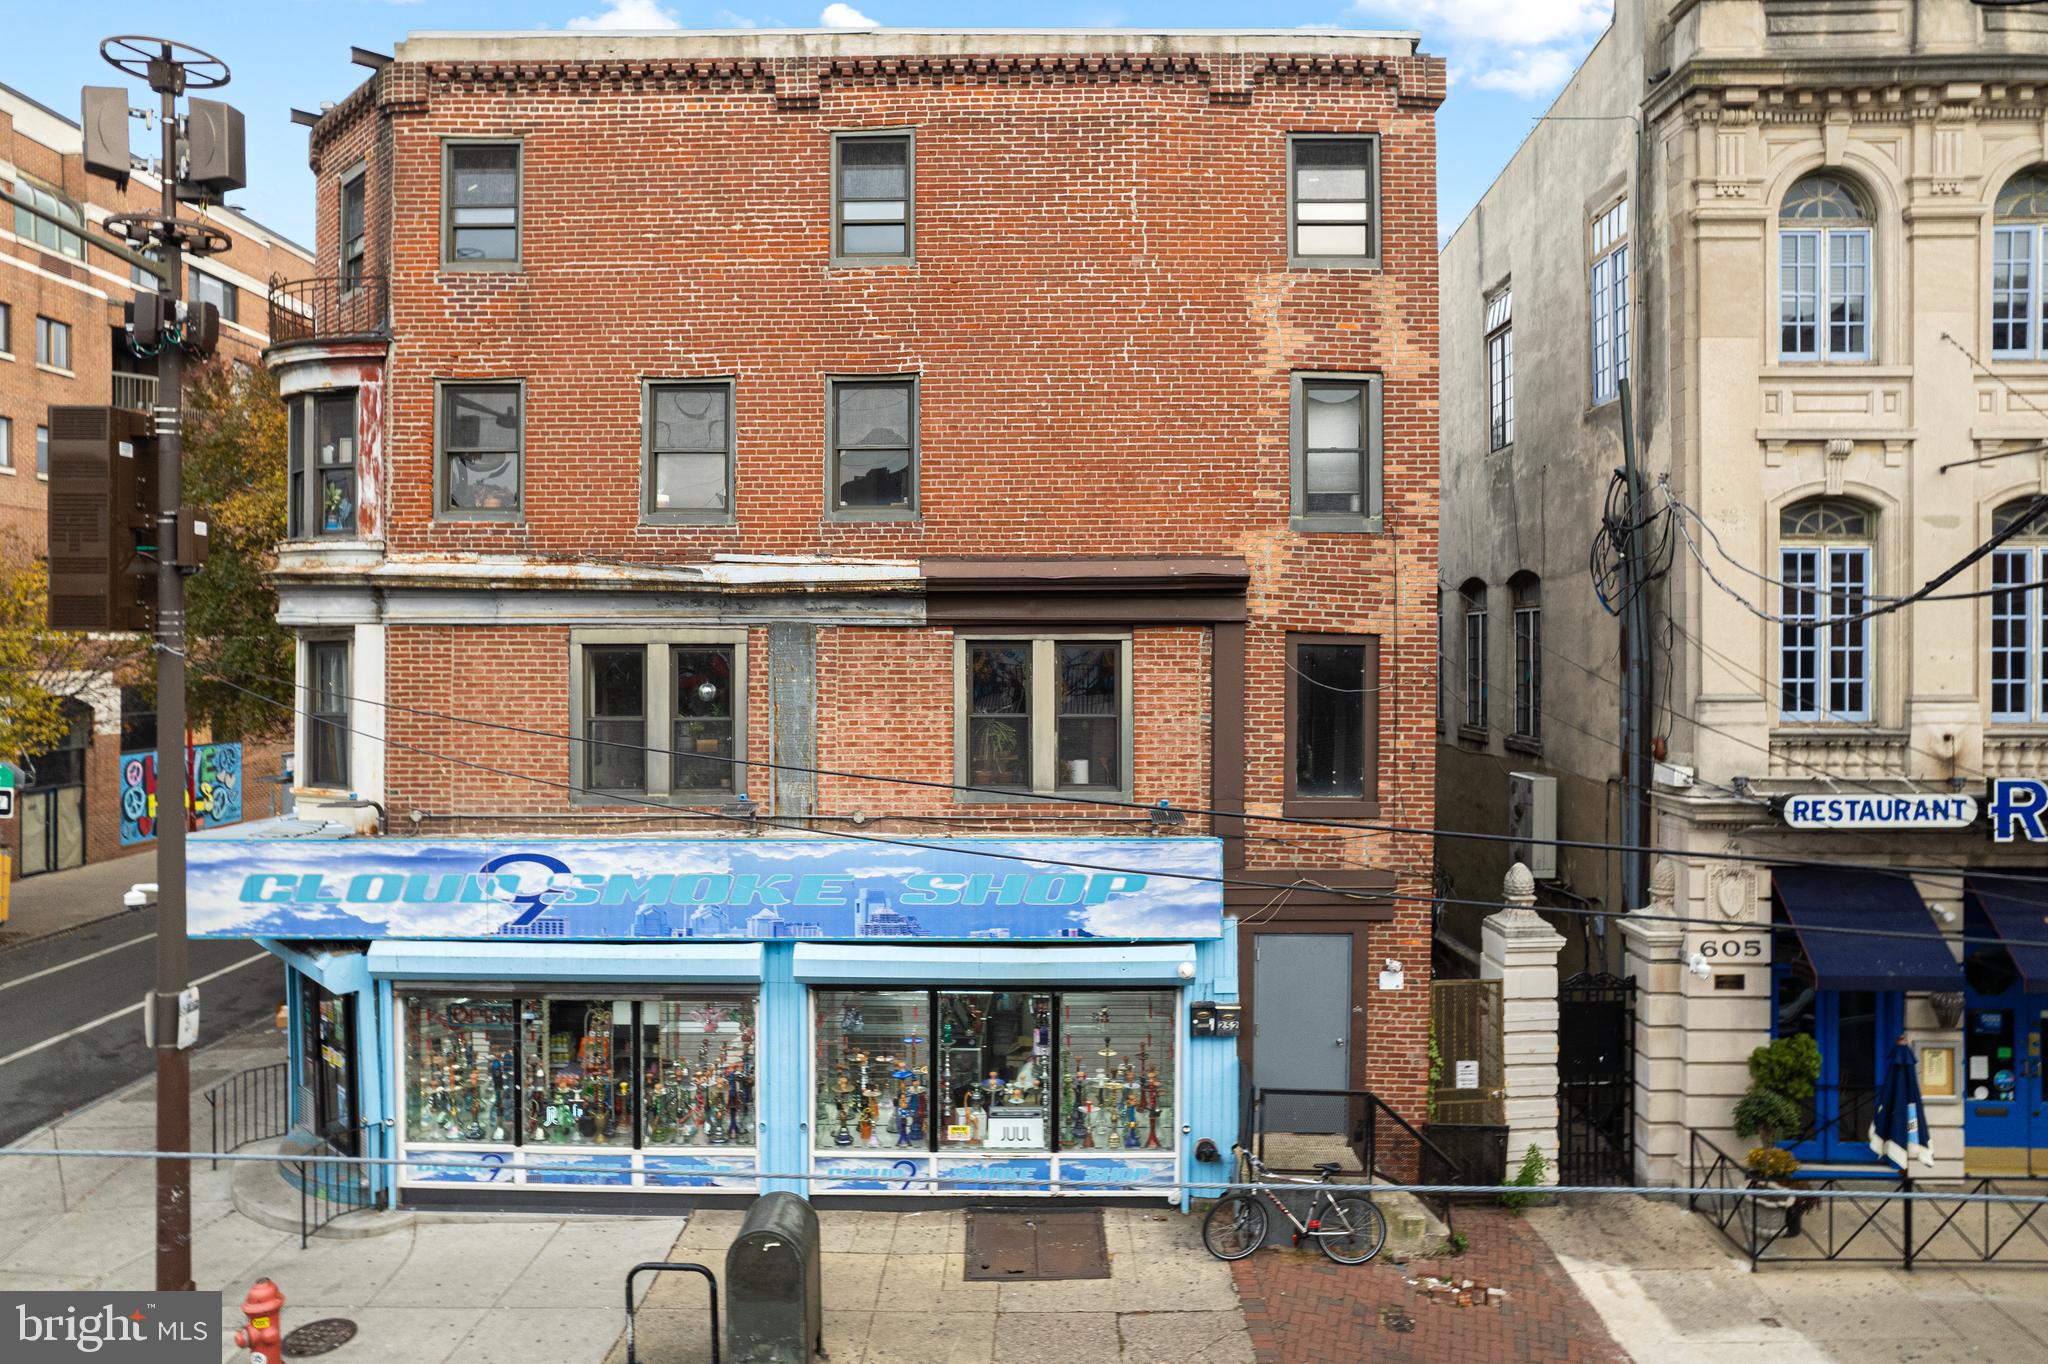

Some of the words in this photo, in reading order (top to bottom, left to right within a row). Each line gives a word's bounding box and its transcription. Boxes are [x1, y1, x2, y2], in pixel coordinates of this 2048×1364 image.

[1793, 799, 1968, 822] RESTAURANT
[239, 873, 523, 903] CLOUD
[475, 853, 572, 927] 9
[540, 873, 855, 905] SMOKE
[900, 873, 1147, 905] SHOP
[1700, 940, 1761, 957] 605
[1001, 1126, 1031, 1141] JUUL
